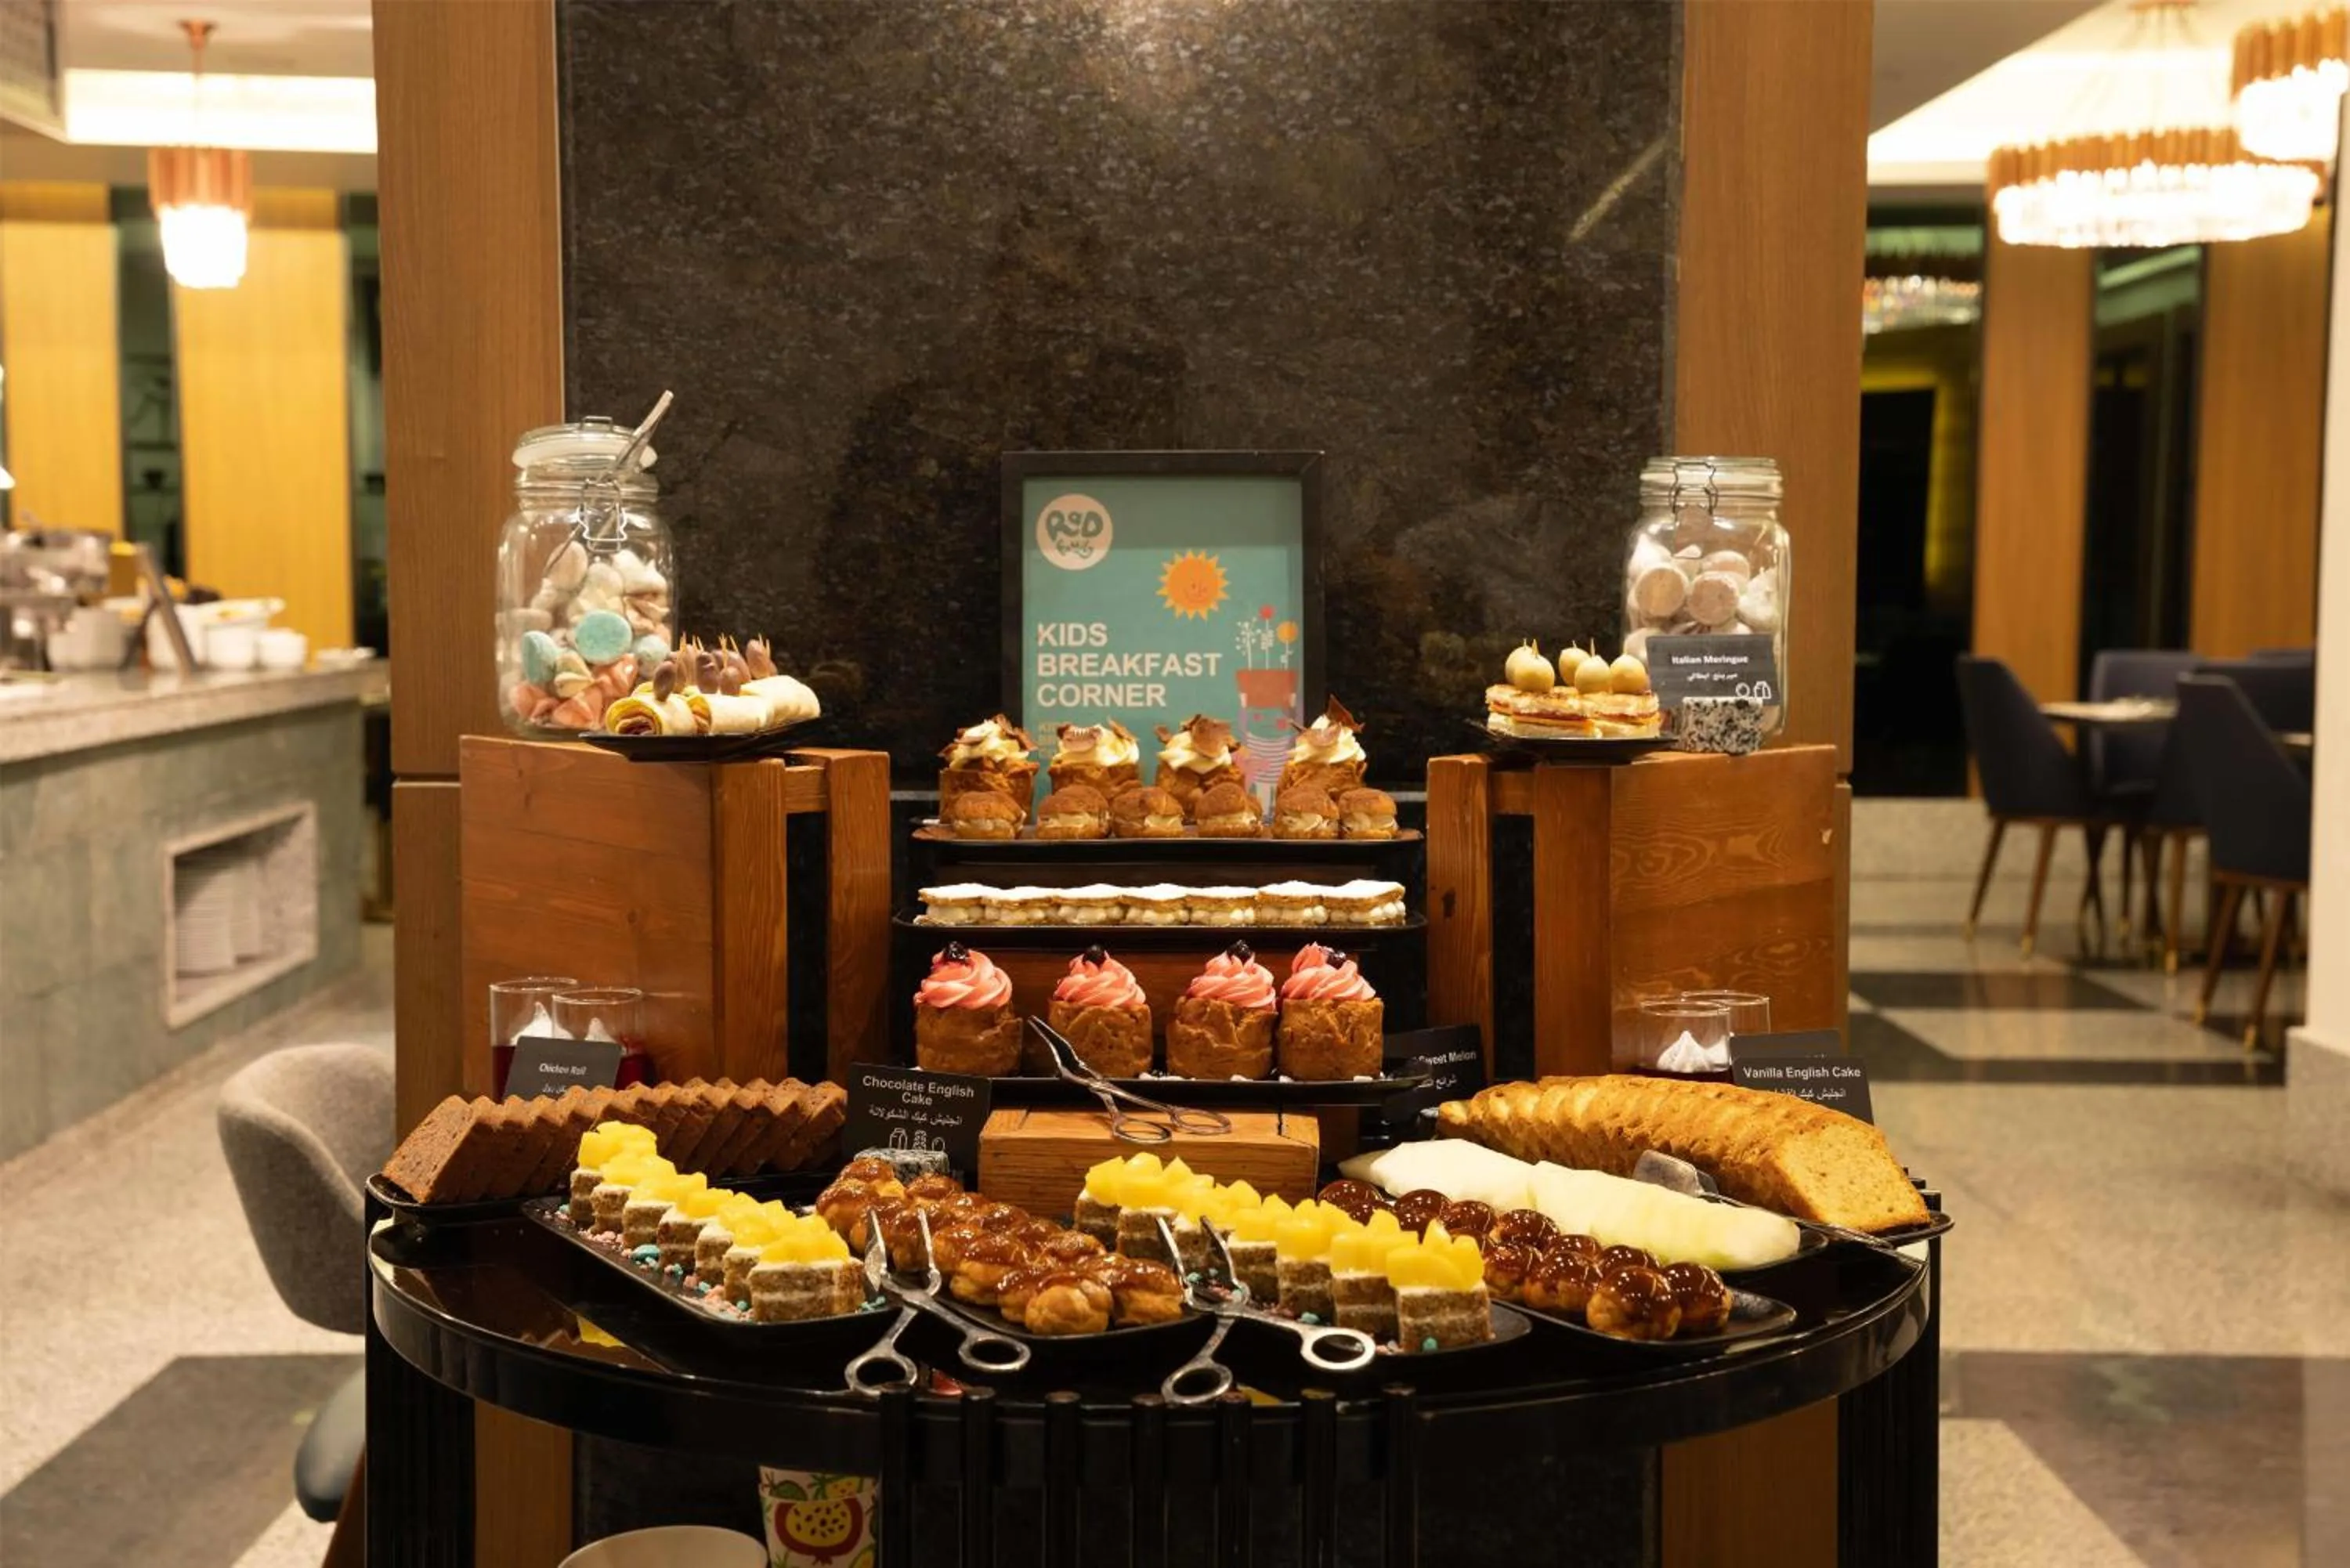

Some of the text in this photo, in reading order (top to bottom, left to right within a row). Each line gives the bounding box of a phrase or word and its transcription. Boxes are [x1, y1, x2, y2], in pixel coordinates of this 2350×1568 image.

[1037, 623, 1108, 647] KIDS
[1037, 652, 1222, 677] BREAKFAST
[1671, 655, 1748, 665] Italian Meringue
[1036, 683, 1166, 707] CORNER
[1448, 1051, 1477, 1063] Melon
[1742, 1066, 1861, 1080] Vanilla English Cake
[862, 1075, 974, 1098] Chocolate English
[902, 1092, 933, 1106] Cake
